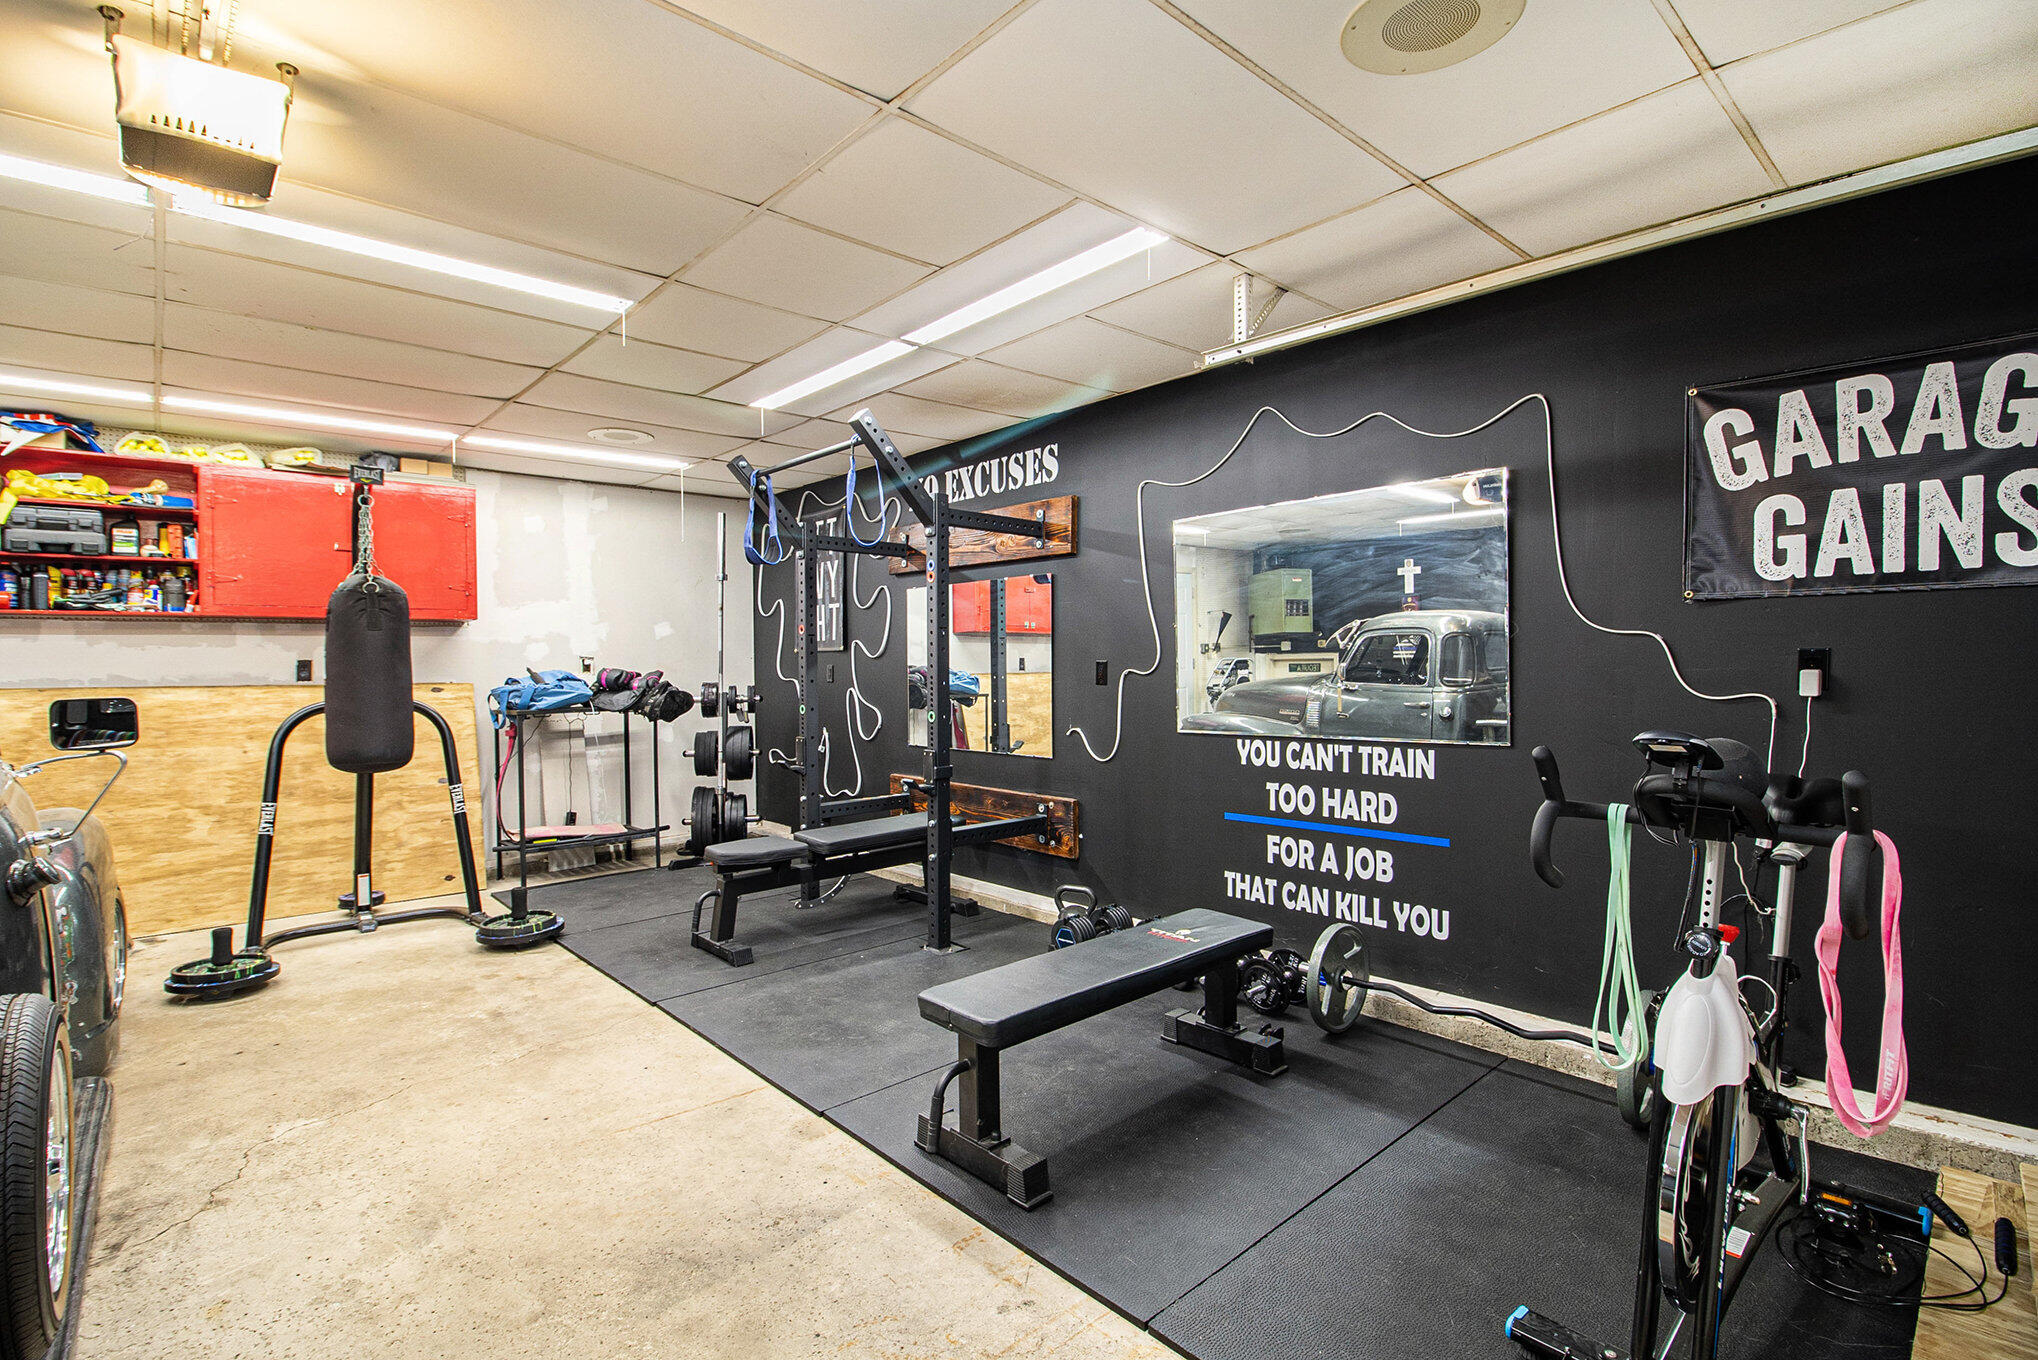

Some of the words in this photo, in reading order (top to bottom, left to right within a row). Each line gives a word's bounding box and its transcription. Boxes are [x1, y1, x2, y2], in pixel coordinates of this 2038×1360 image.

[945, 443, 1060, 504] EXCUSES
[1753, 468, 2038, 582] GAINS
[1237, 739, 1280, 768] YOU
[1286, 742, 1353, 773] CAN'T
[1358, 745, 1436, 780] TRAIN
[258, 802, 277, 836] EVERLAST
[449, 784, 467, 815] EVERLAST
[1266, 782, 1316, 816] TOO
[1322, 787, 1398, 825] HARD
[1266, 834, 1315, 871] FOR
[1320, 842, 1339, 875] A
[1344, 845, 1394, 883] JOB
[1224, 870, 1278, 906] THAT
[1281, 881, 1329, 917] CAN
[1335, 890, 1388, 929] KILL
[1392, 901, 1451, 941] YOU
